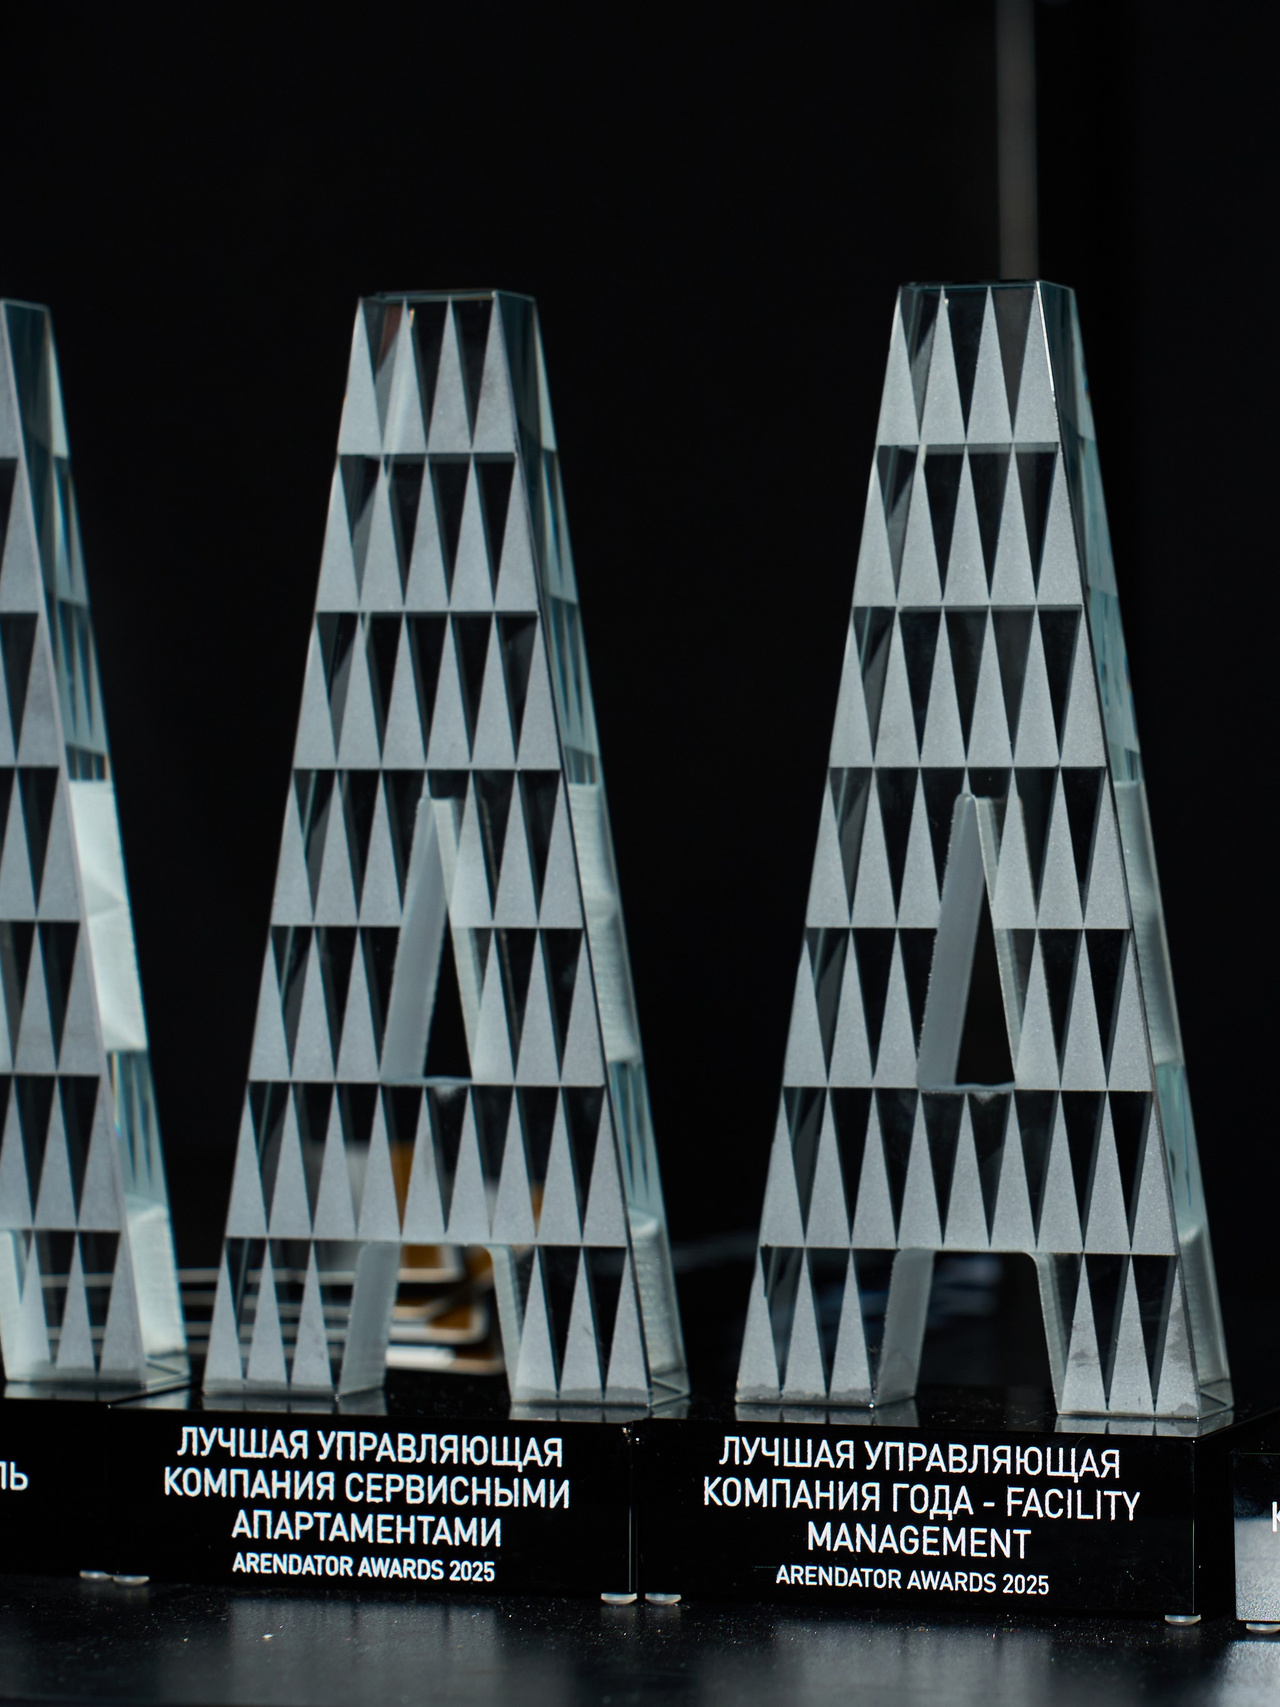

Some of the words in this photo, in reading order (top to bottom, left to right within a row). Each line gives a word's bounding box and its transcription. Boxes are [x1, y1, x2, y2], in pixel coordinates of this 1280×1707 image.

[177, 1426, 309, 1460] ЛУЧШАЯ
[318, 1430, 563, 1473] УПРАВЛЯЮЩАЯ
[718, 1435, 855, 1470] ЛУЧШАЯ
[863, 1440, 1120, 1484] УПРАВЛЯЮЩАЯ
[164, 1466, 335, 1501] КОМПАНИЯ
[345, 1472, 570, 1509] СЕРВИСНЫМИ
[703, 1476, 880, 1512] КОМПАНИЯ
[892, 1482, 974, 1522] ГОДА
[1006, 1486, 1141, 1522] FACILITY
[231, 1509, 501, 1548] АПАРТАМЕНТАМИ
[807, 1520, 1032, 1560] MANAGEMENT
[232, 1551, 354, 1577] ARENDATOR
[357, 1556, 445, 1581] AWARDS
[448, 1559, 496, 1582] 2025
[775, 1564, 902, 1590] ARENDATOR
[906, 1569, 997, 1594] AWARDS
[1002, 1573, 1050, 1596] 2025
